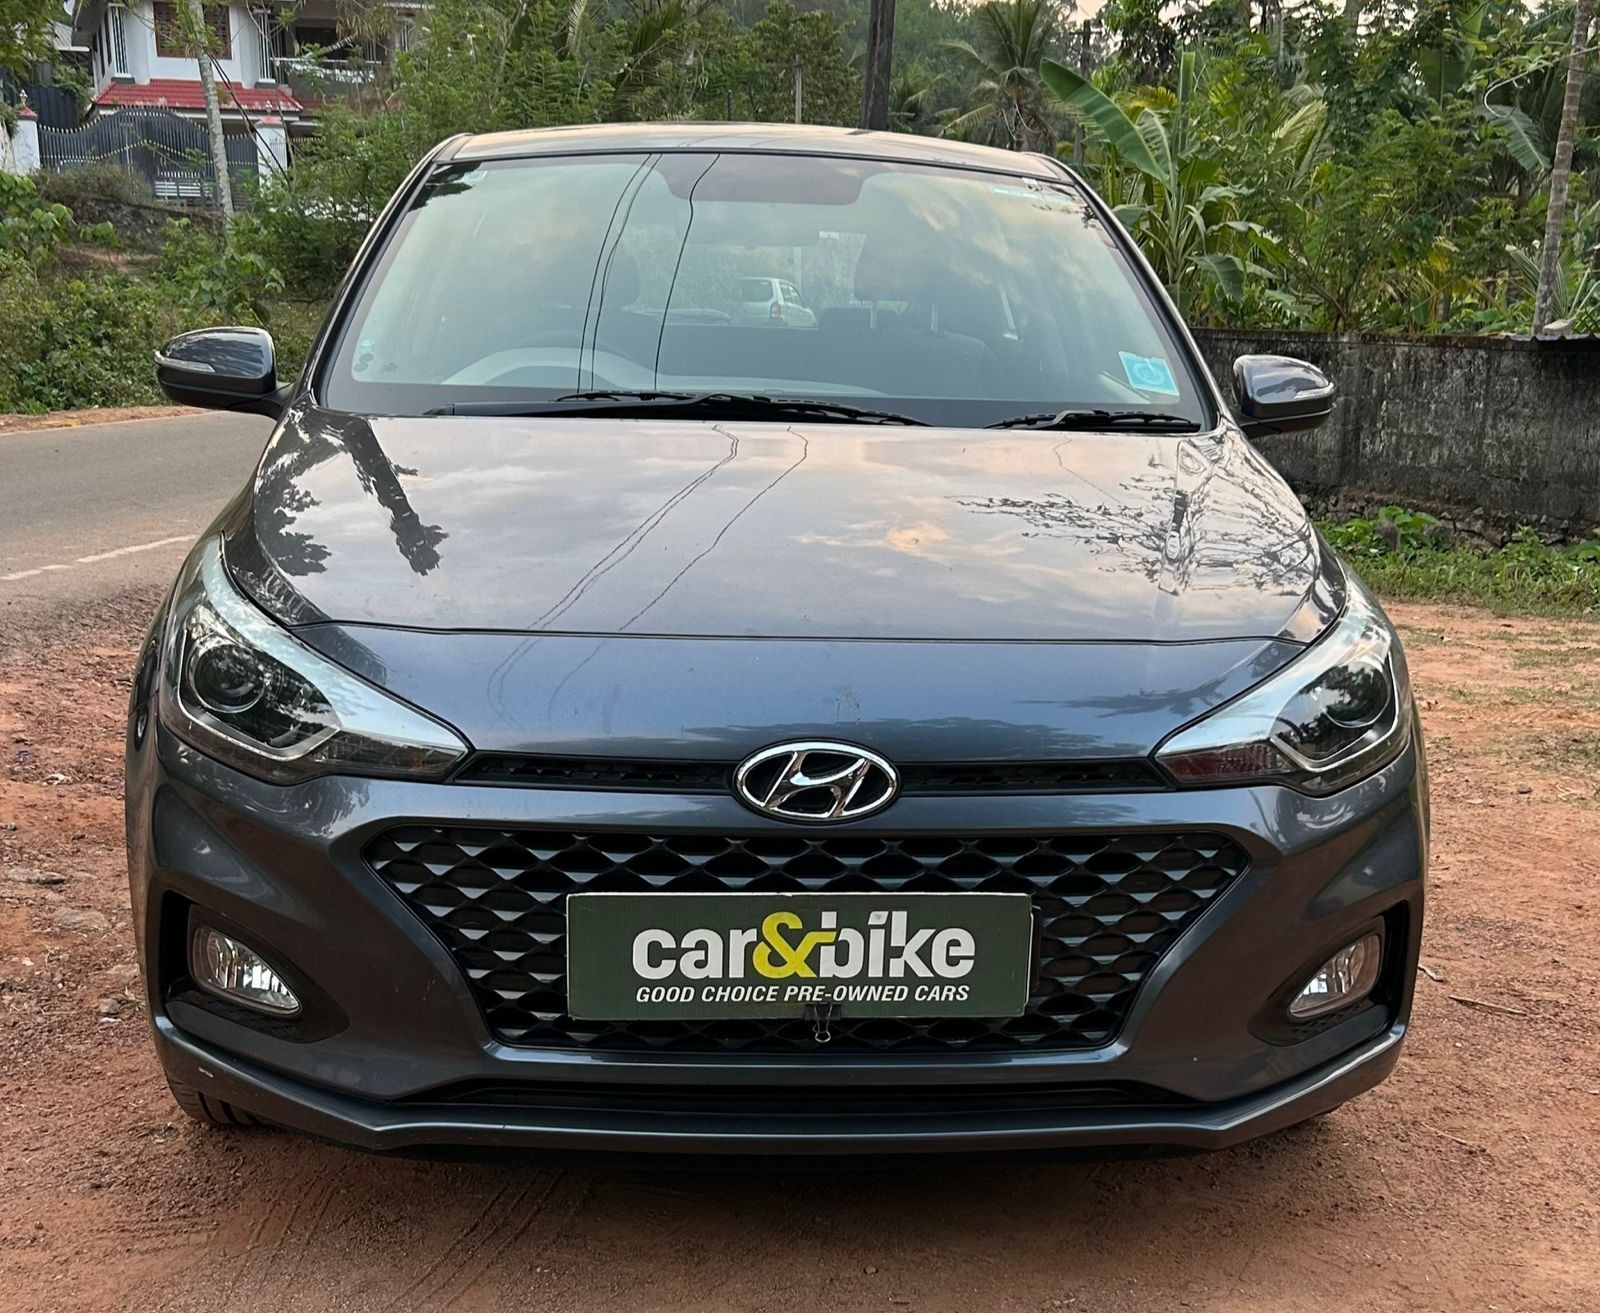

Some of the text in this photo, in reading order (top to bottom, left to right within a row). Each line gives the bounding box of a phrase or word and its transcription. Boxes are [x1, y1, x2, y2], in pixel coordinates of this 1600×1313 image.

[632, 910, 976, 980] car&bike
[636, 984, 970, 1003] GOOD CHOICE PRE-OWNED CARS
